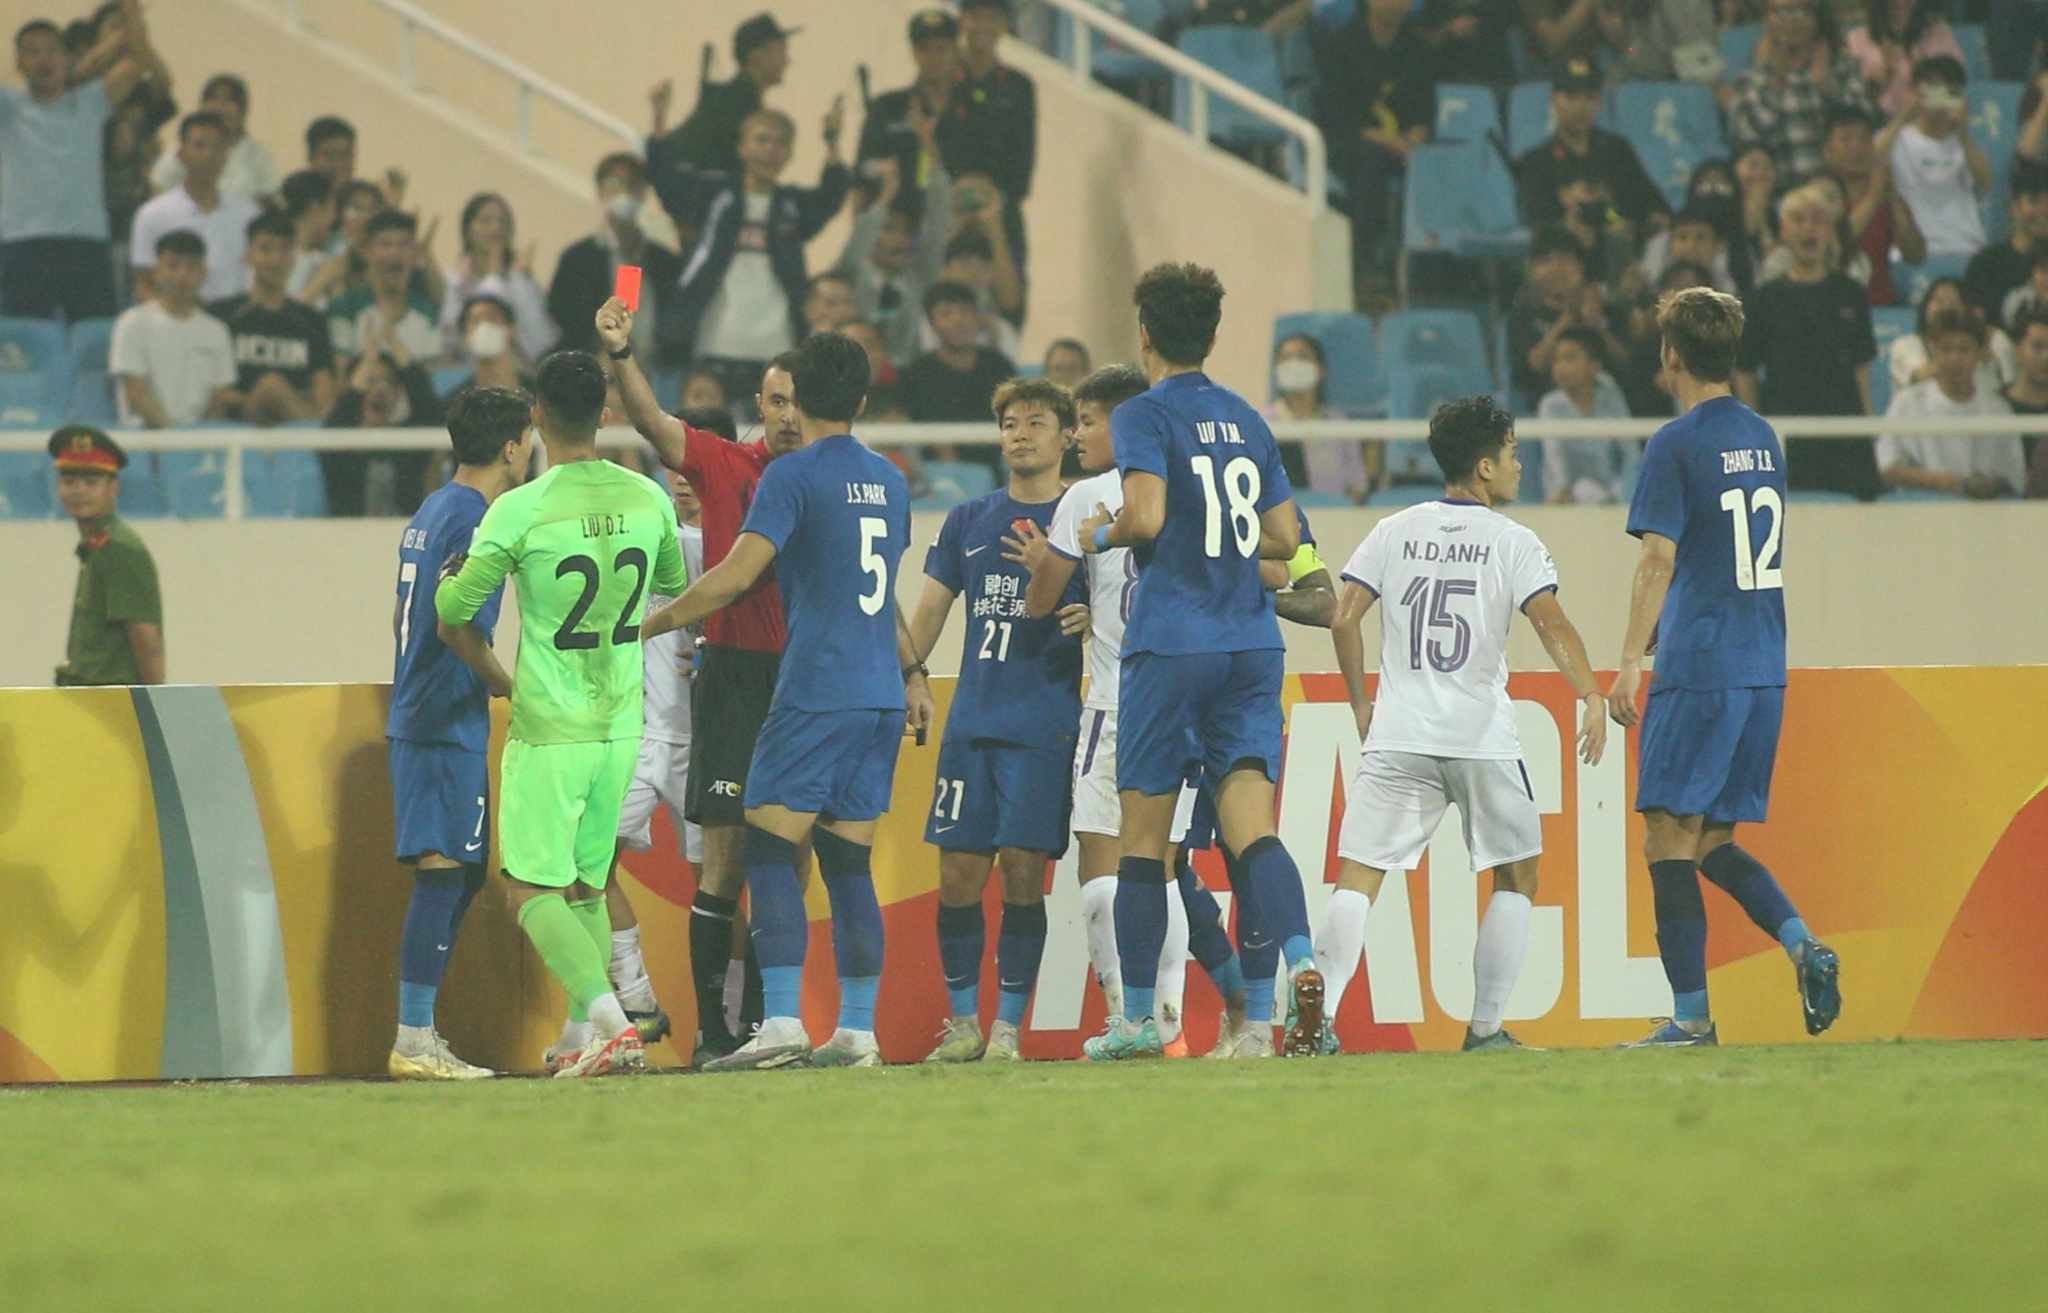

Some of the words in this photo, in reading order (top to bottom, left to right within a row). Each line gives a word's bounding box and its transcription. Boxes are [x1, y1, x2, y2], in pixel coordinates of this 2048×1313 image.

[1195, 420, 1216, 444] LIU
[1720, 448, 1754, 474] ZHANG
[580, 516, 600, 538] LIU
[1191, 455, 1261, 559] 18
[1402, 540, 1490, 565] N.D.ANH
[1720, 486, 1783, 591] 12
[858, 517, 888, 617] 5
[984, 574, 1020, 597] 融创
[401, 562, 417, 657] 7
[553, 547, 648, 651] 22
[978, 619, 1013, 662] 21
[1400, 576, 1477, 673] 15
[708, 780, 739, 797] AFC
[935, 777, 964, 820] 21
[473, 796, 485, 837] 7
